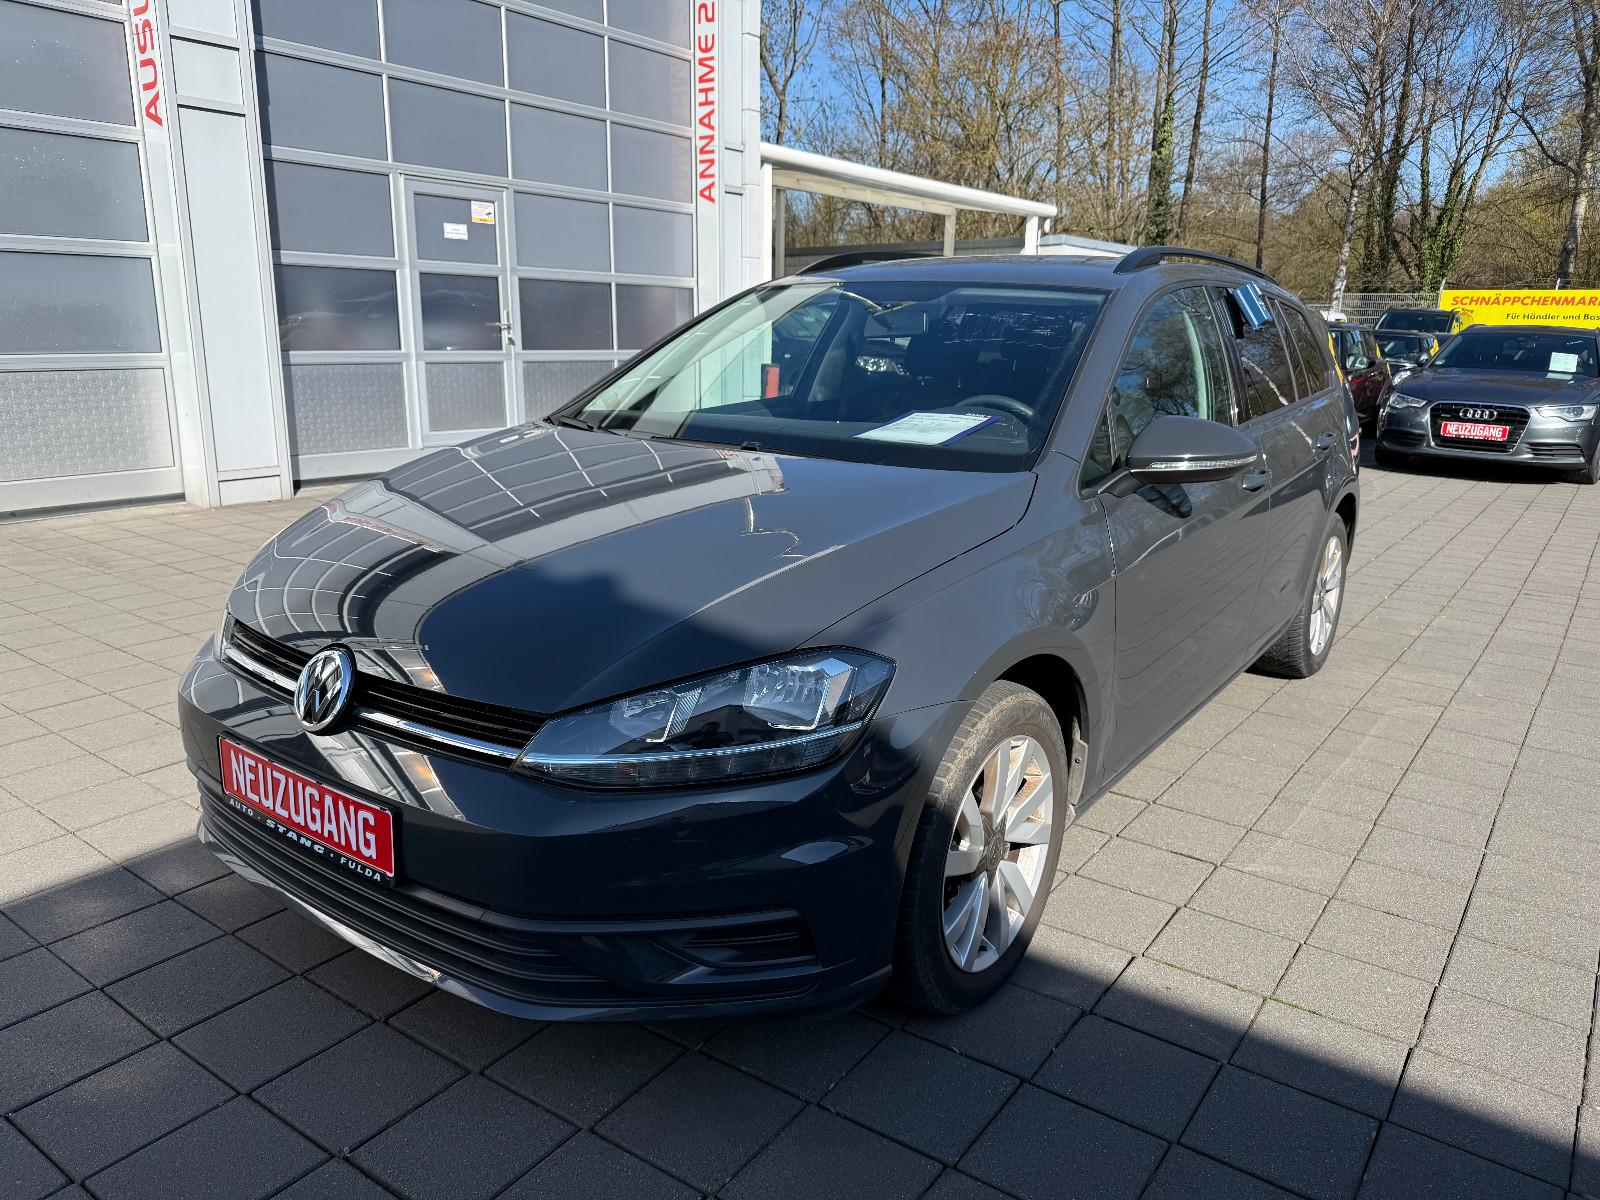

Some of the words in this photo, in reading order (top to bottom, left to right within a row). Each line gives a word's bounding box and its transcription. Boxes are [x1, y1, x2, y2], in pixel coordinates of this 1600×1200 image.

[697, 1, 715, 24] 2
[697, 33, 715, 204] ANNAHME
[1451, 293, 1600, 306] SCHNÄPPCHENMAR
[1446, 423, 1503, 438] NEUZUGANG
[230, 748, 377, 860] NEUZUGANG
[229, 798, 254, 817] AUTO
[266, 819, 325, 854] STANG
[340, 857, 382, 882] FULDA
